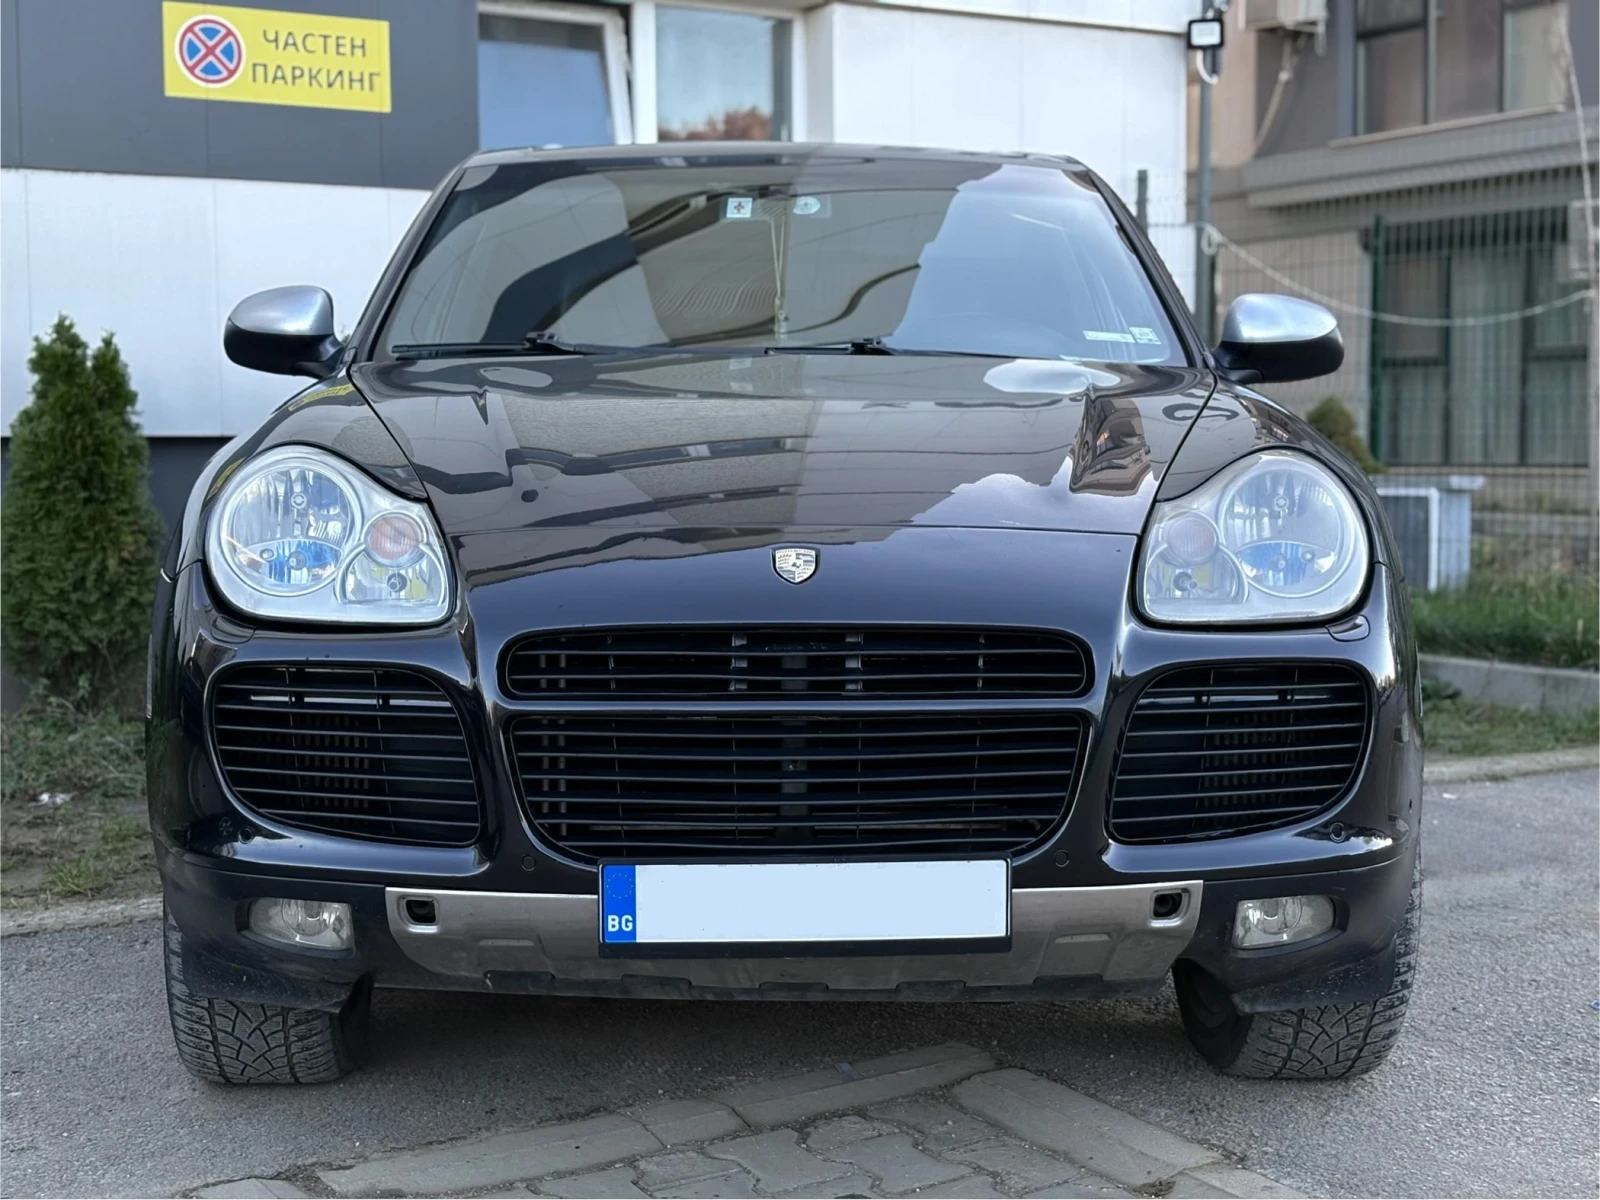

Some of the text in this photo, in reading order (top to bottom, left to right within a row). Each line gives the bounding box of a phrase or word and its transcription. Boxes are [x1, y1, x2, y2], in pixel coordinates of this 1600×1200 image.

[263, 29, 366, 57] ЧАСТЕН
[252, 63, 381, 92] ПАРКИНГ
[607, 914, 633, 932] BG
